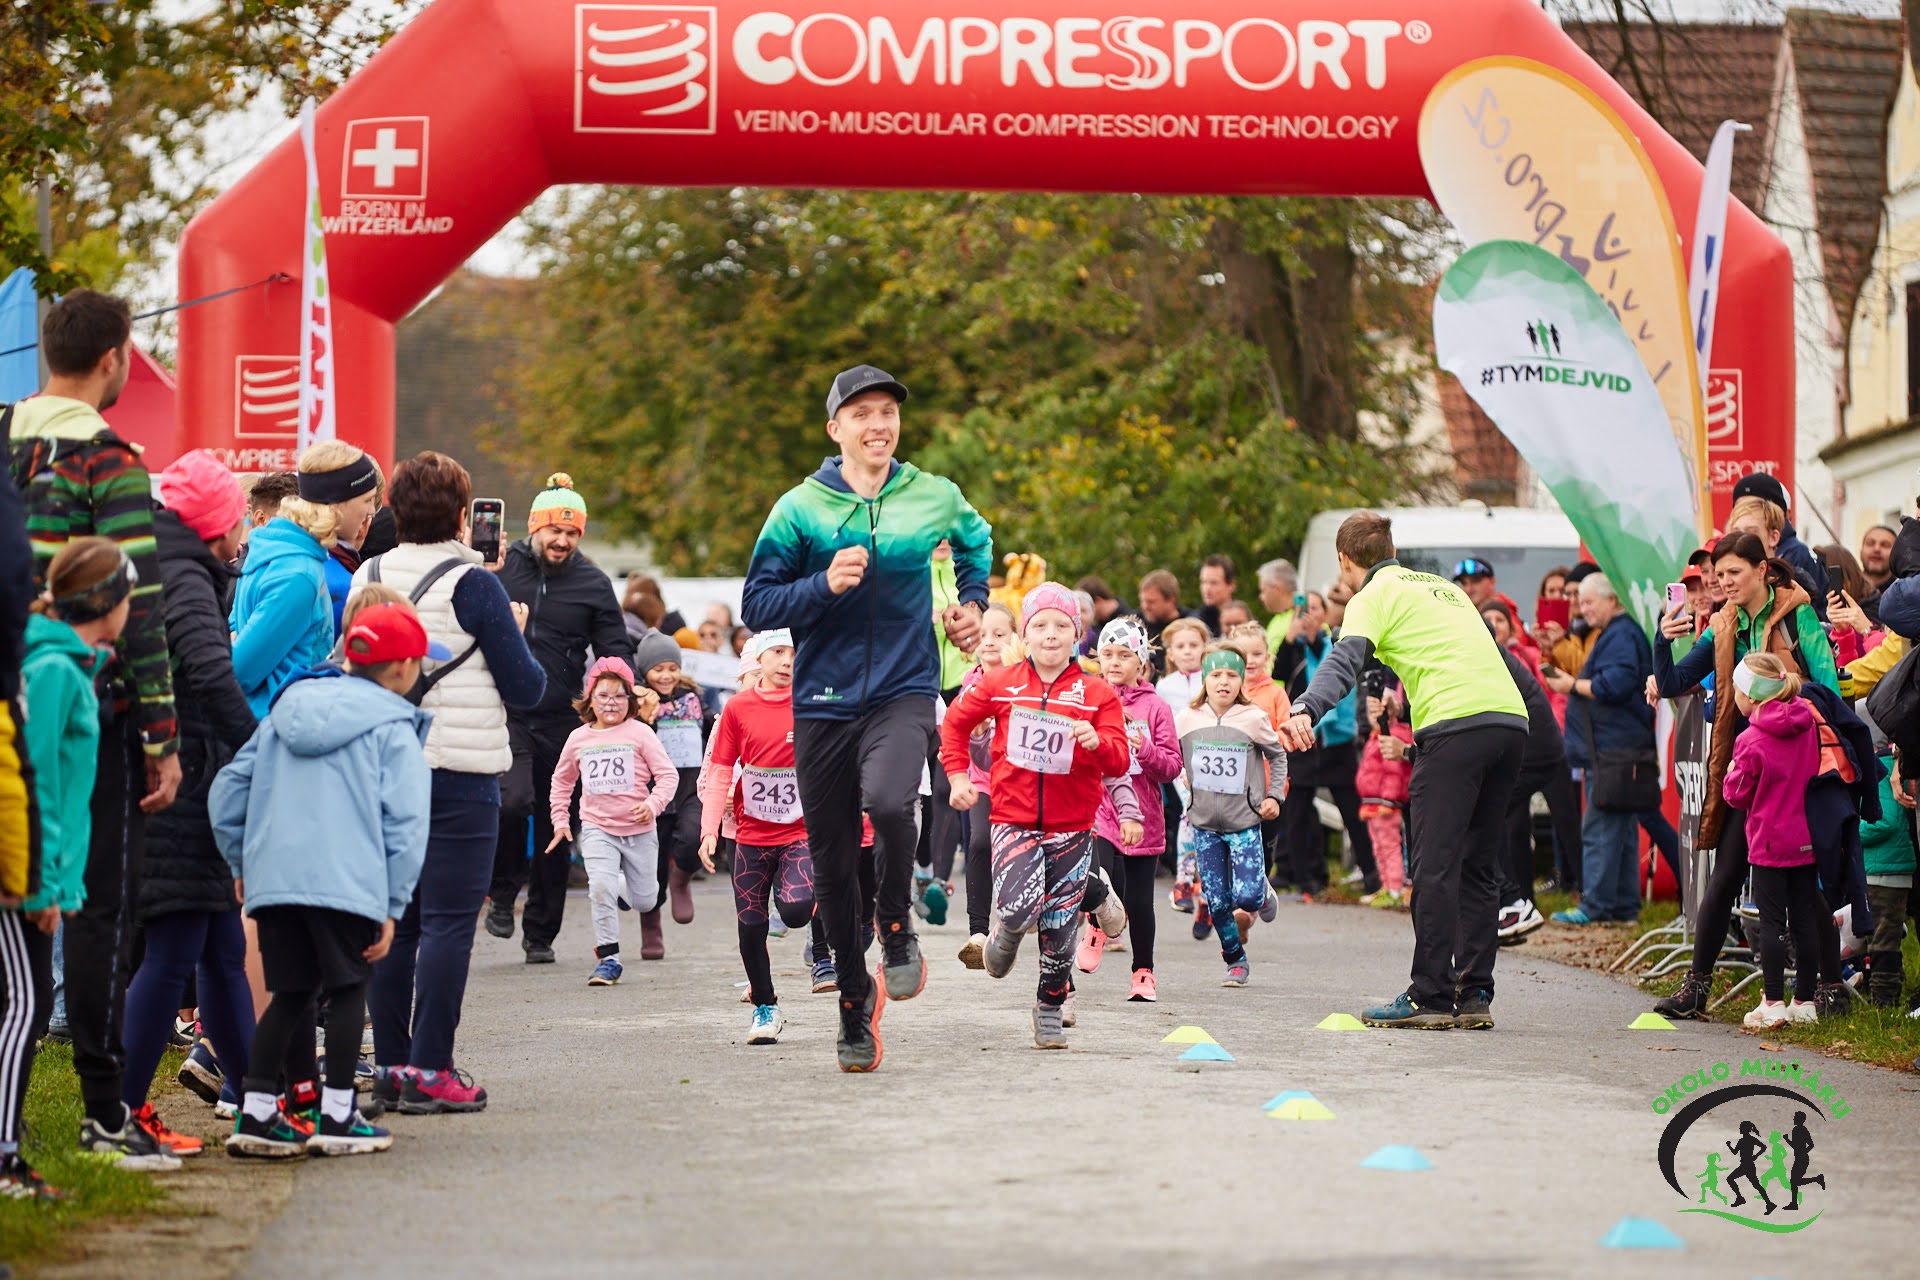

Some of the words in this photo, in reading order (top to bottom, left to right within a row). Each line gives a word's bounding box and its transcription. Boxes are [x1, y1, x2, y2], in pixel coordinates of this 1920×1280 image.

[734, 109, 987, 136] VEINO-MUSCULAR
[993, 112, 1199, 139] COMPRESSION
[1206, 115, 1399, 139] TECHNOLOGY
[341, 200, 399, 217] BORN
[404, 202, 426, 217] IN
[322, 215, 454, 235] WITZERLAND
[1481, 364, 1632, 393] #TYMDEJVID
[1013, 710, 1039, 721] OKOLO
[1040, 716, 1073, 728] MUŇÁK
[1018, 725, 1064, 755] 120
[1022, 751, 1053, 764] ELENA
[1200, 756, 1238, 777] 333
[587, 757, 625, 779] 278
[744, 768, 769, 778] OKOLO
[770, 769, 796, 779] MUŇÁ
[751, 781, 797, 805] 243
[758, 804, 790, 815] ELIŠKA
